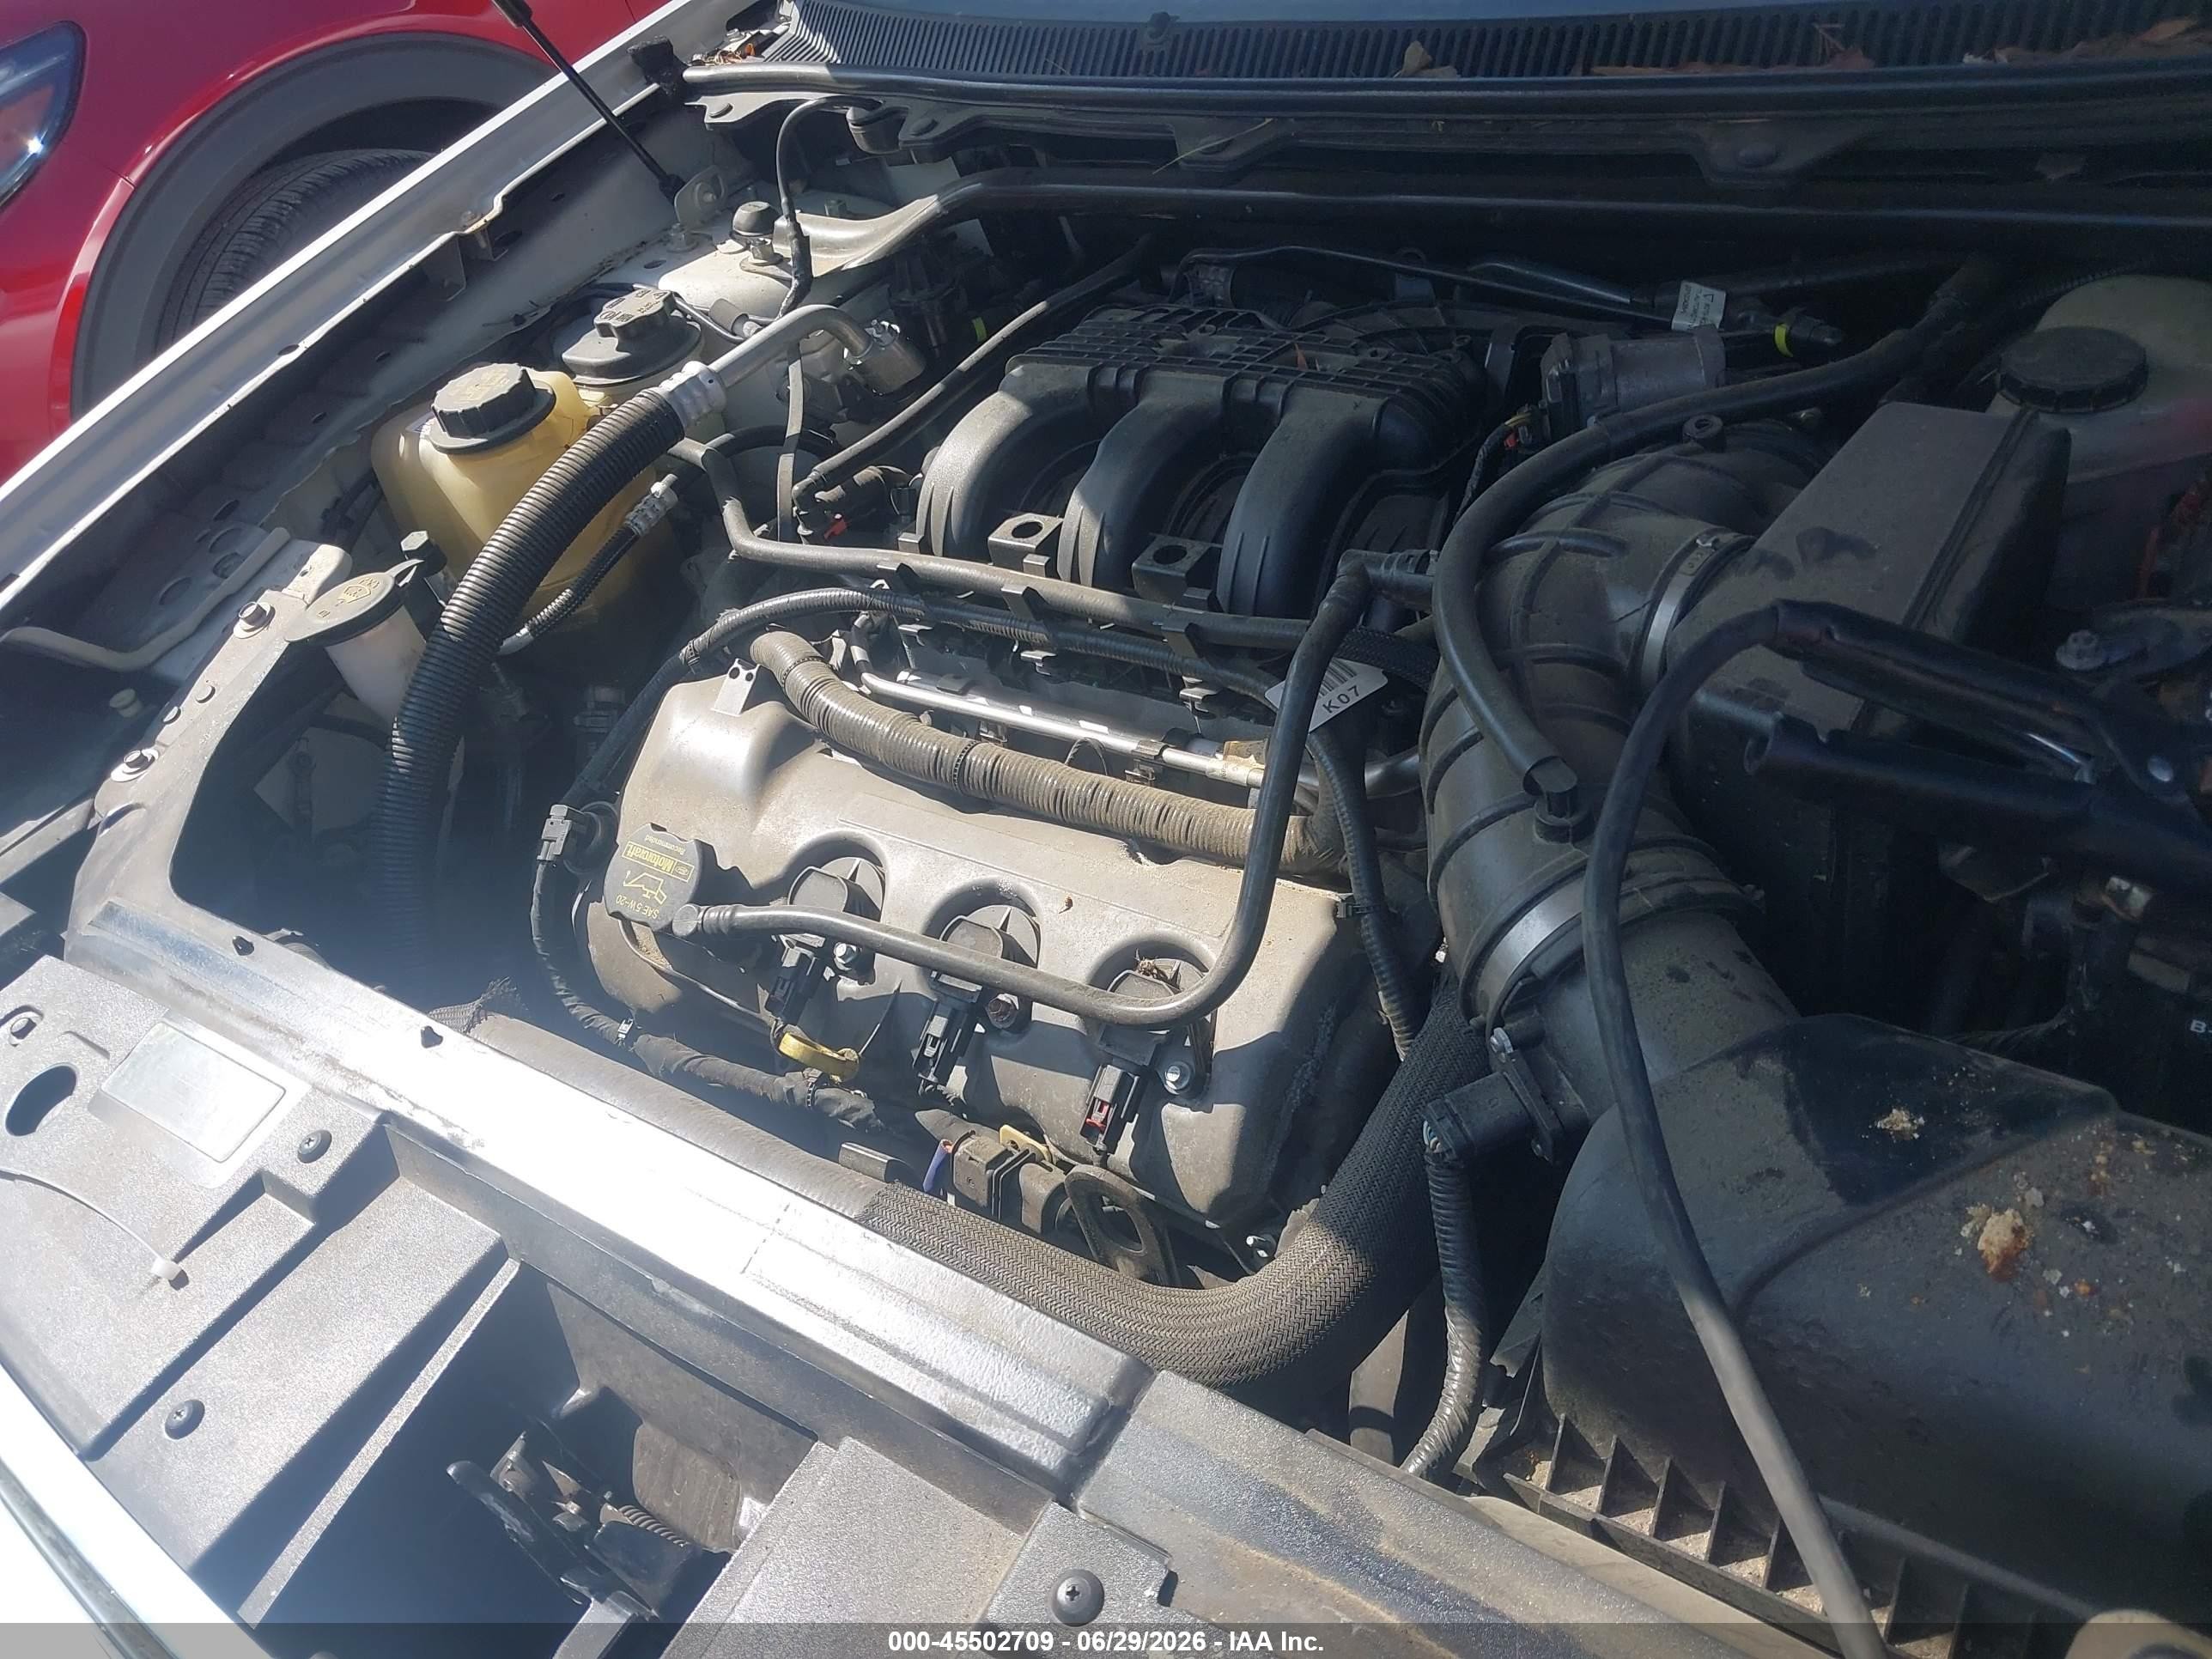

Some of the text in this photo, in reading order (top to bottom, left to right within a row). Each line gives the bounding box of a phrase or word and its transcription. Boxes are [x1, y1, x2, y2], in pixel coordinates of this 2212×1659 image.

[1322, 685, 1360, 714] K07
[646, 835, 685, 854] Recommended
[627, 844, 675, 872] Motorcraft
[643, 905, 659, 920] SAE
